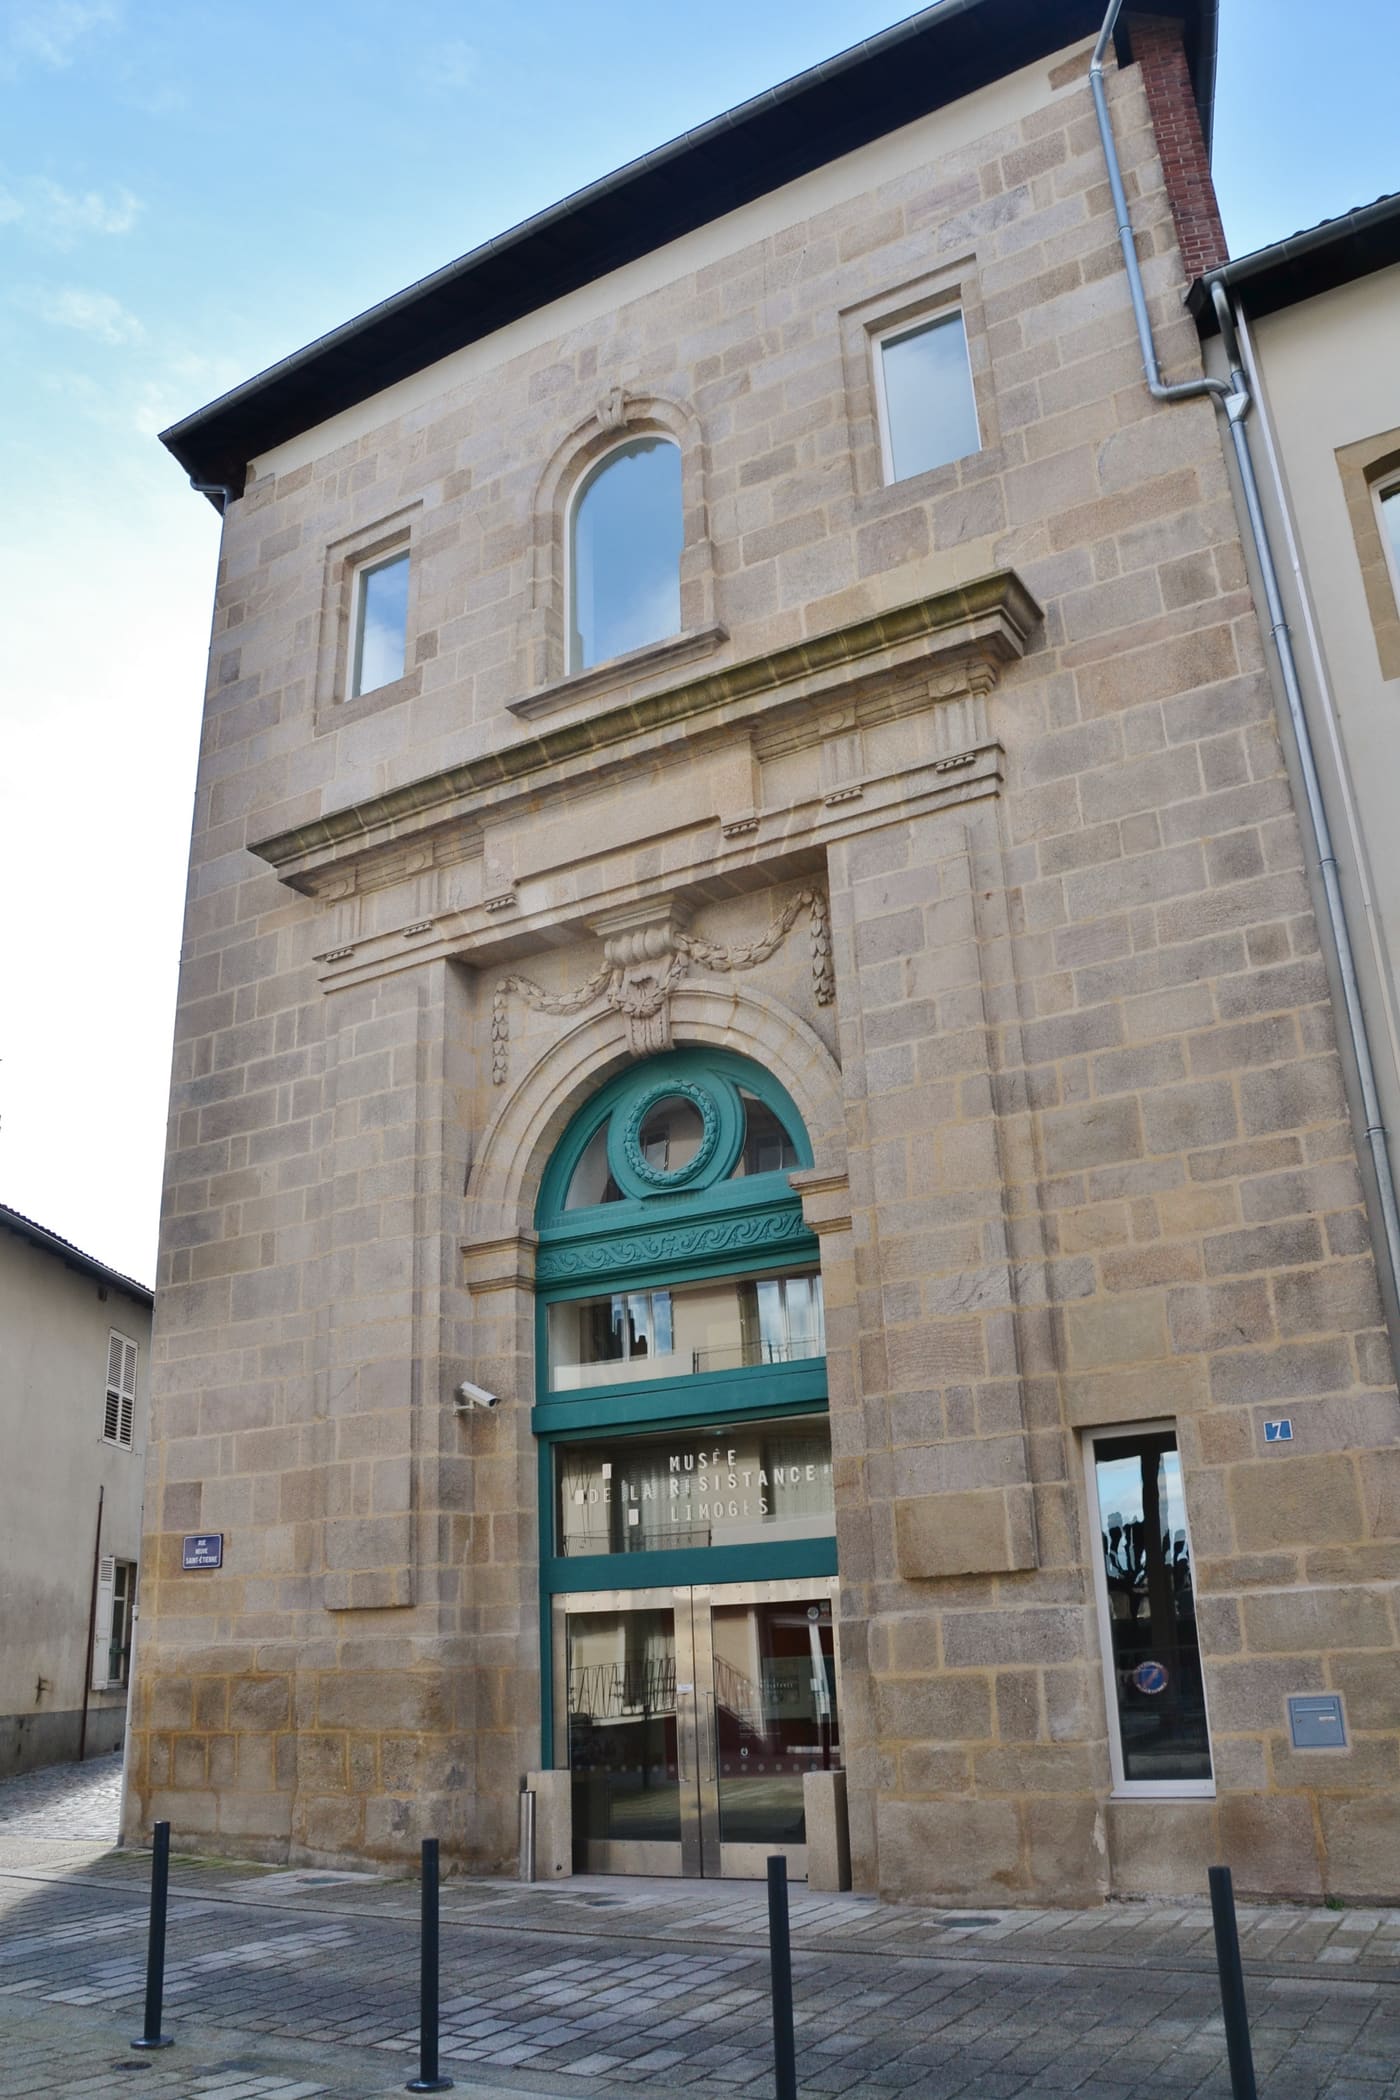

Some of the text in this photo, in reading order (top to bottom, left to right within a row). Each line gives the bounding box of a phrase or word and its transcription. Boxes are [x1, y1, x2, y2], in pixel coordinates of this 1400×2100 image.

[1272, 1422, 1282, 1439] 7
[669, 1448, 736, 1472] MUSÉE
[589, 1487, 611, 1504] DE
[630, 1483, 653, 1501] LA
